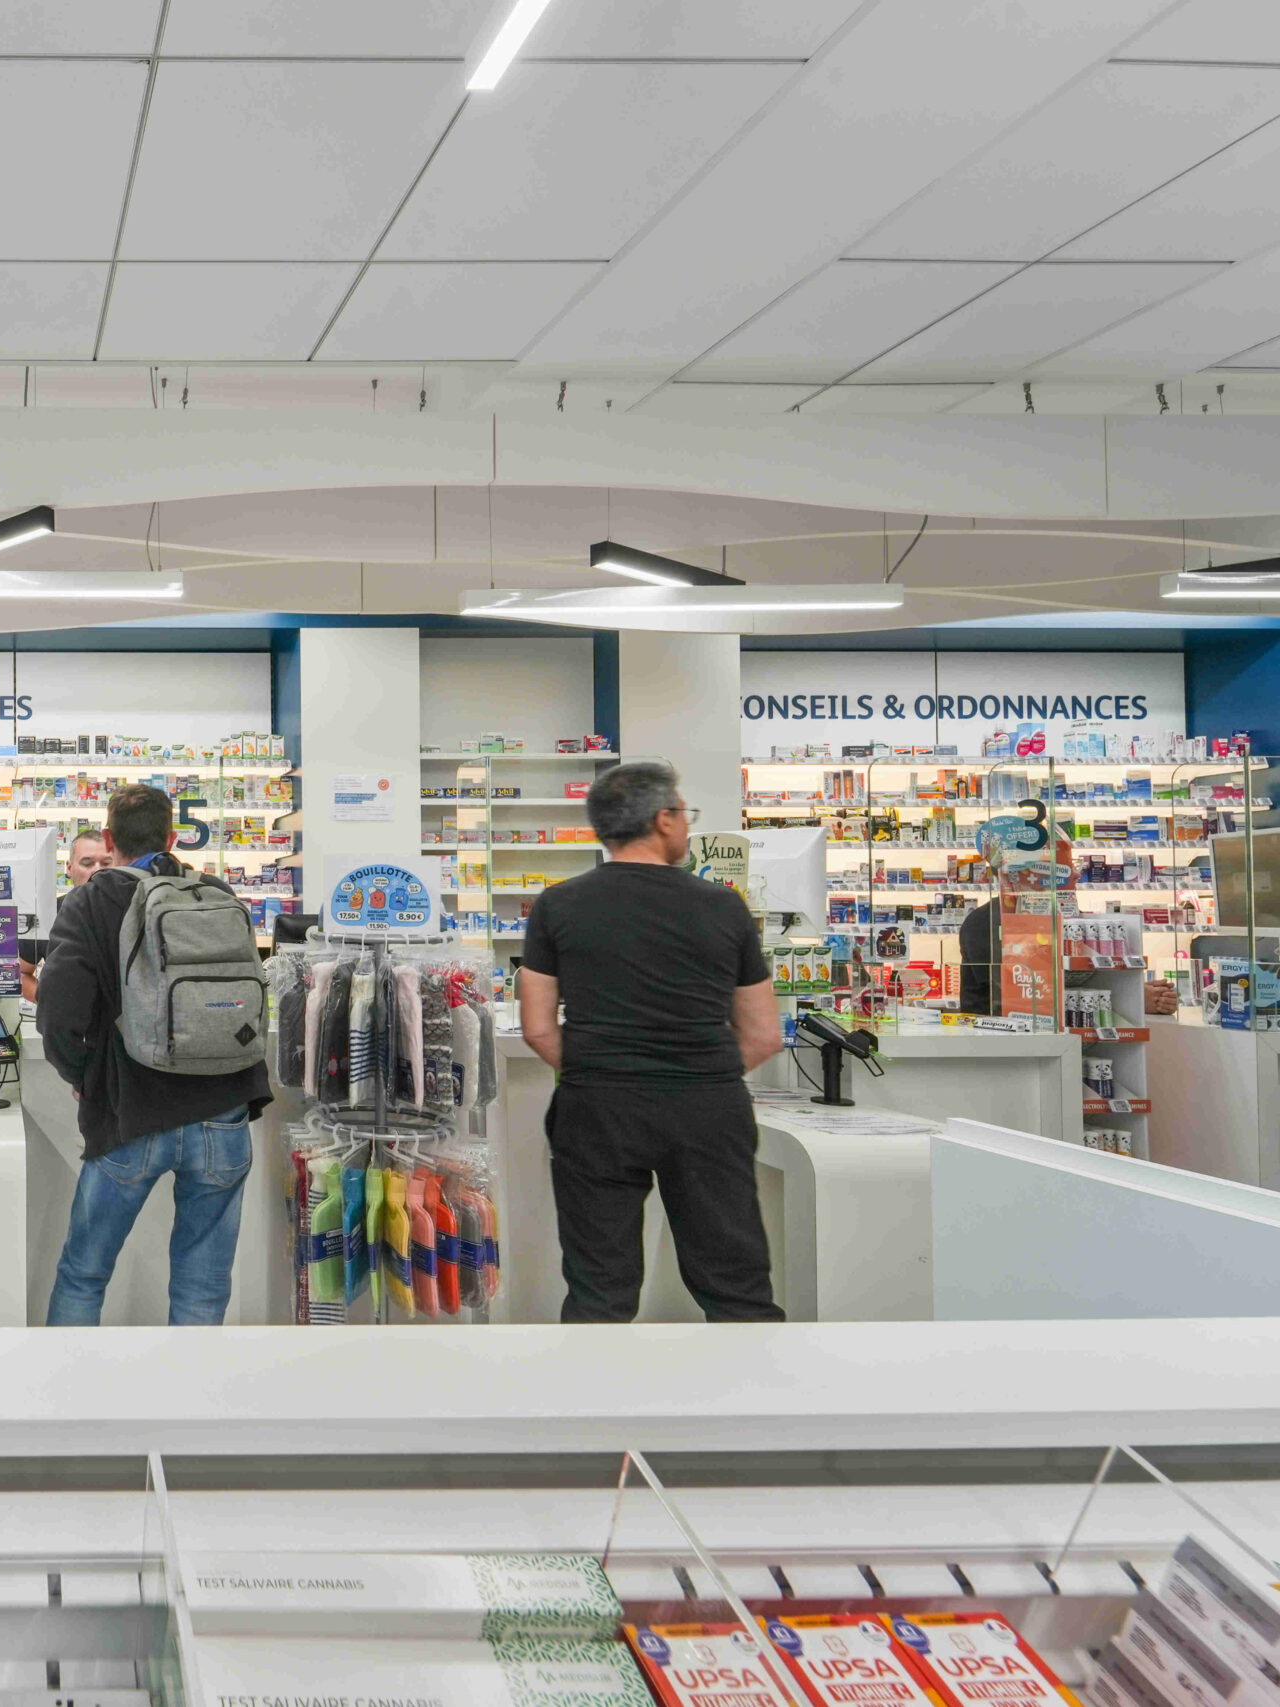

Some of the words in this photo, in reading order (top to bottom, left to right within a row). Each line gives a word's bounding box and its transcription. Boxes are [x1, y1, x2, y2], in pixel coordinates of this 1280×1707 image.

[740, 695, 874, 720] ONSEILS
[882, 695, 906, 720] &
[914, 695, 1148, 720] ORDONNANCES
[176, 799, 210, 850] 5
[1016, 799, 1048, 851] 3
[1006, 830, 1037, 840] OFFERT
[700, 836, 743, 864] VALDA
[349, 867, 413, 883] BOUILLOTTE
[1012, 964, 1044, 985] Panda
[1017, 983, 1044, 999] Tea
[981, 1020, 1014, 1030] Fixodent
[197, 1578, 226, 1589] TEST
[229, 1578, 294, 1589] SALIVAIRE
[298, 1579, 365, 1590] CANNABIS
[807, 1658, 900, 1680] UPSA
[936, 1656, 1030, 1677] UPSA
[673, 1668, 766, 1689] UPSA
[828, 1684, 894, 1701] VITAMINE
[897, 1684, 911, 1699] C
[961, 1681, 1026, 1699] VITAMINE
[1027, 1681, 1043, 1696] C
[217, 1696, 258, 1707] TEST
[262, 1696, 348, 1707] SALIVAIRE
[355, 1697, 444, 1707] CANNABIS
